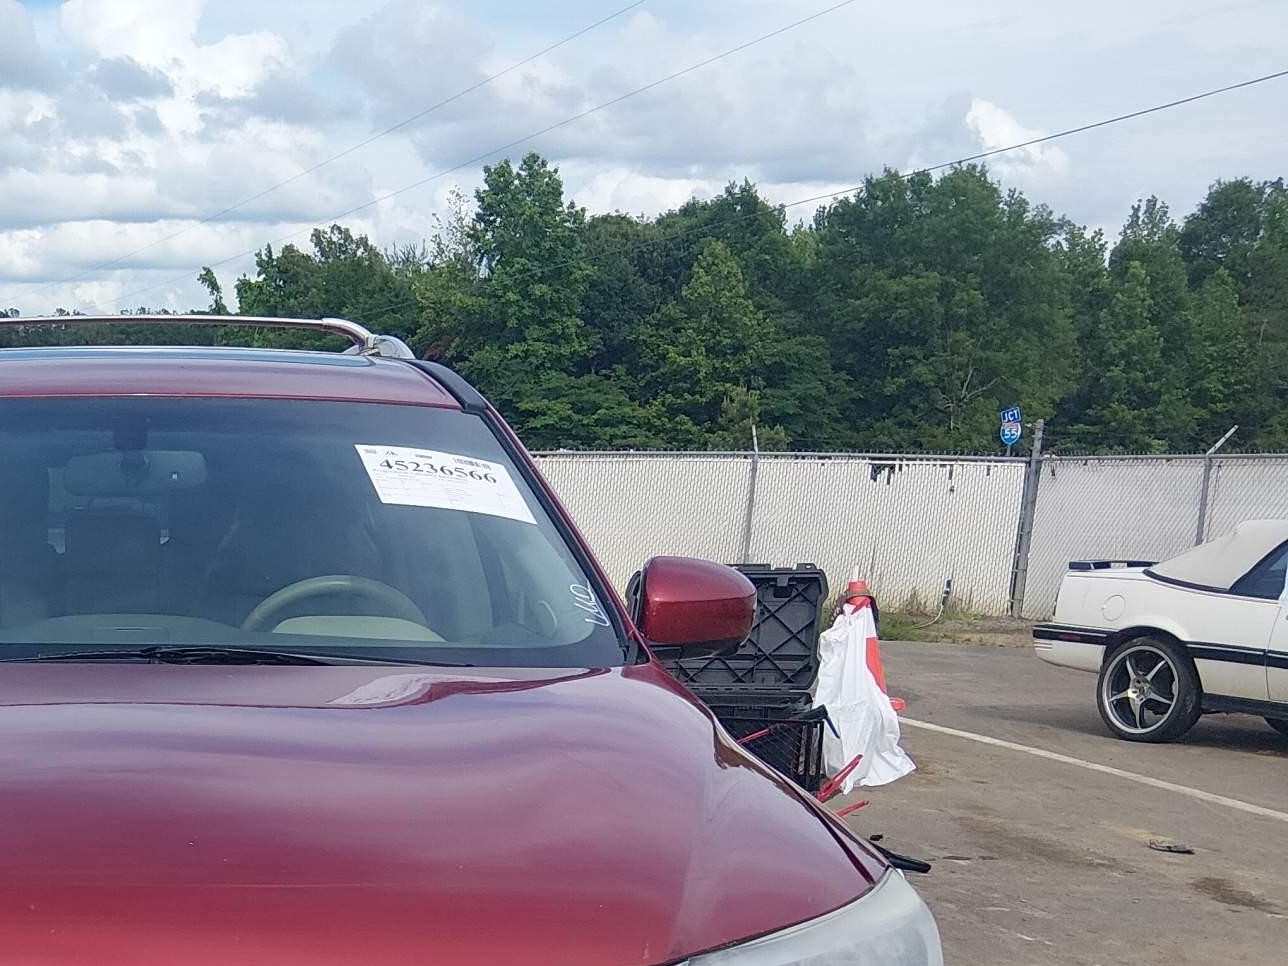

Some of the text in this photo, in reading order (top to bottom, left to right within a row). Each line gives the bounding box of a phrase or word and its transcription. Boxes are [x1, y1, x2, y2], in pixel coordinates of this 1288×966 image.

[1004, 410, 1018, 421] JCT
[1004, 428, 1017, 438] 55
[379, 459, 497, 484] 45236566
